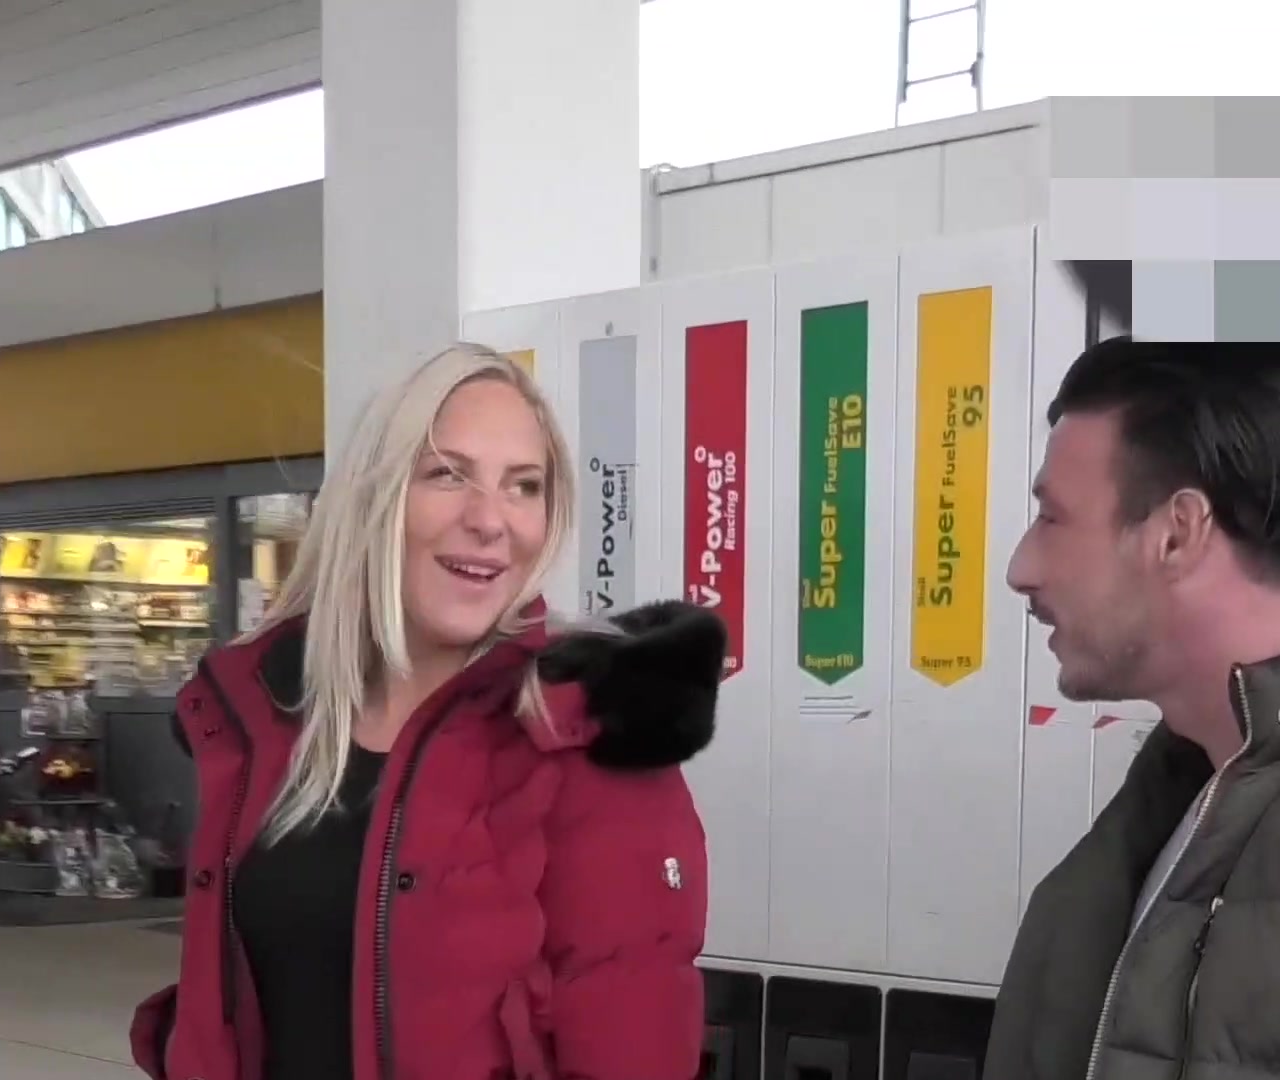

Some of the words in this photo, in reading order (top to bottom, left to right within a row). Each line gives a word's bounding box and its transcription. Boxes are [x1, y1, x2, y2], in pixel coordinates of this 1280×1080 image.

[824, 396, 838, 494] FuelSave
[841, 394, 863, 449] E10
[942, 385, 957, 487] FuelSave
[962, 384, 984, 428] 95
[617, 469, 628, 522] Diesel
[724, 451, 737, 483] 100
[596, 463, 616, 610] V-Power
[700, 452, 723, 609] V-Power
[724, 490, 739, 551] Racing
[814, 500, 843, 609] Super
[929, 495, 961, 608] Super
